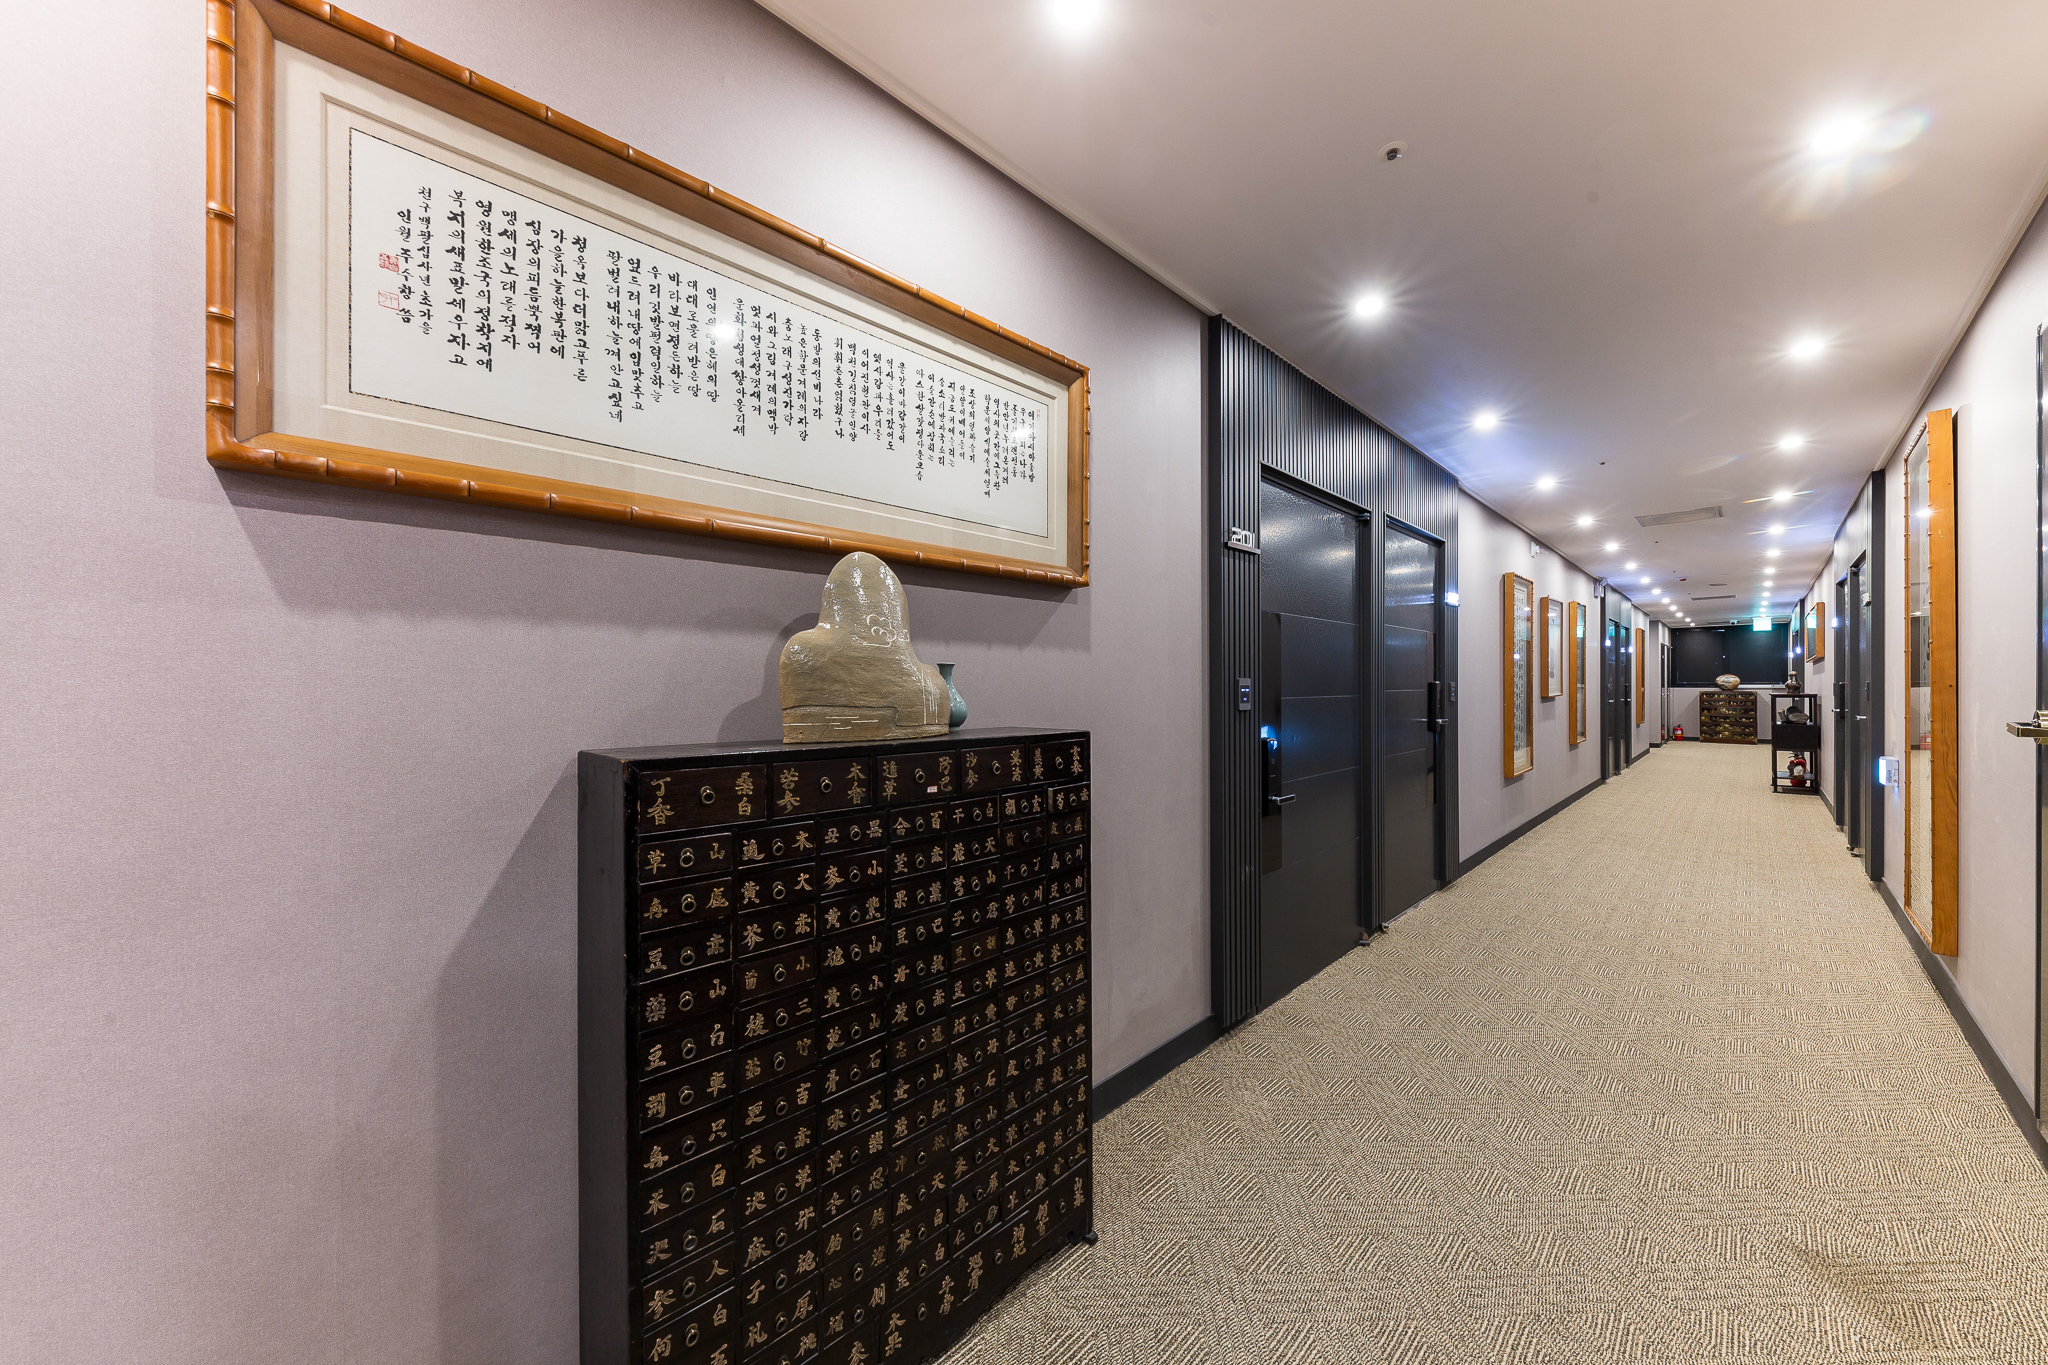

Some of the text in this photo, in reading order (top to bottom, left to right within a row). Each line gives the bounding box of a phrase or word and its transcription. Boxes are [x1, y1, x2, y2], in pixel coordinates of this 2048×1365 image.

[845, 762, 866, 805] 木香
[646, 776, 675, 826] 丁香
[930, 810, 943, 829] 百
[791, 830, 814, 852] 木
[984, 836, 996, 853] 天
[709, 842, 726, 860] 山
[867, 859, 883, 876] 小
[986, 869, 996, 884] 山
[794, 872, 813, 891] 大
[952, 910, 965, 927] 子
[868, 935, 882, 954] 山
[895, 926, 909, 946] 豆
[644, 947, 668, 974] 豆
[709, 978, 727, 999] 山
[868, 974, 884, 991] 小
[795, 997, 812, 1016] 三
[869, 1013, 880, 1030] 山
[647, 1044, 667, 1071] 豆
[868, 1048, 882, 1069] 石
[932, 1063, 944, 1081] 山
[706, 1208, 725, 1235] 石
[705, 1259, 729, 1283] 人
